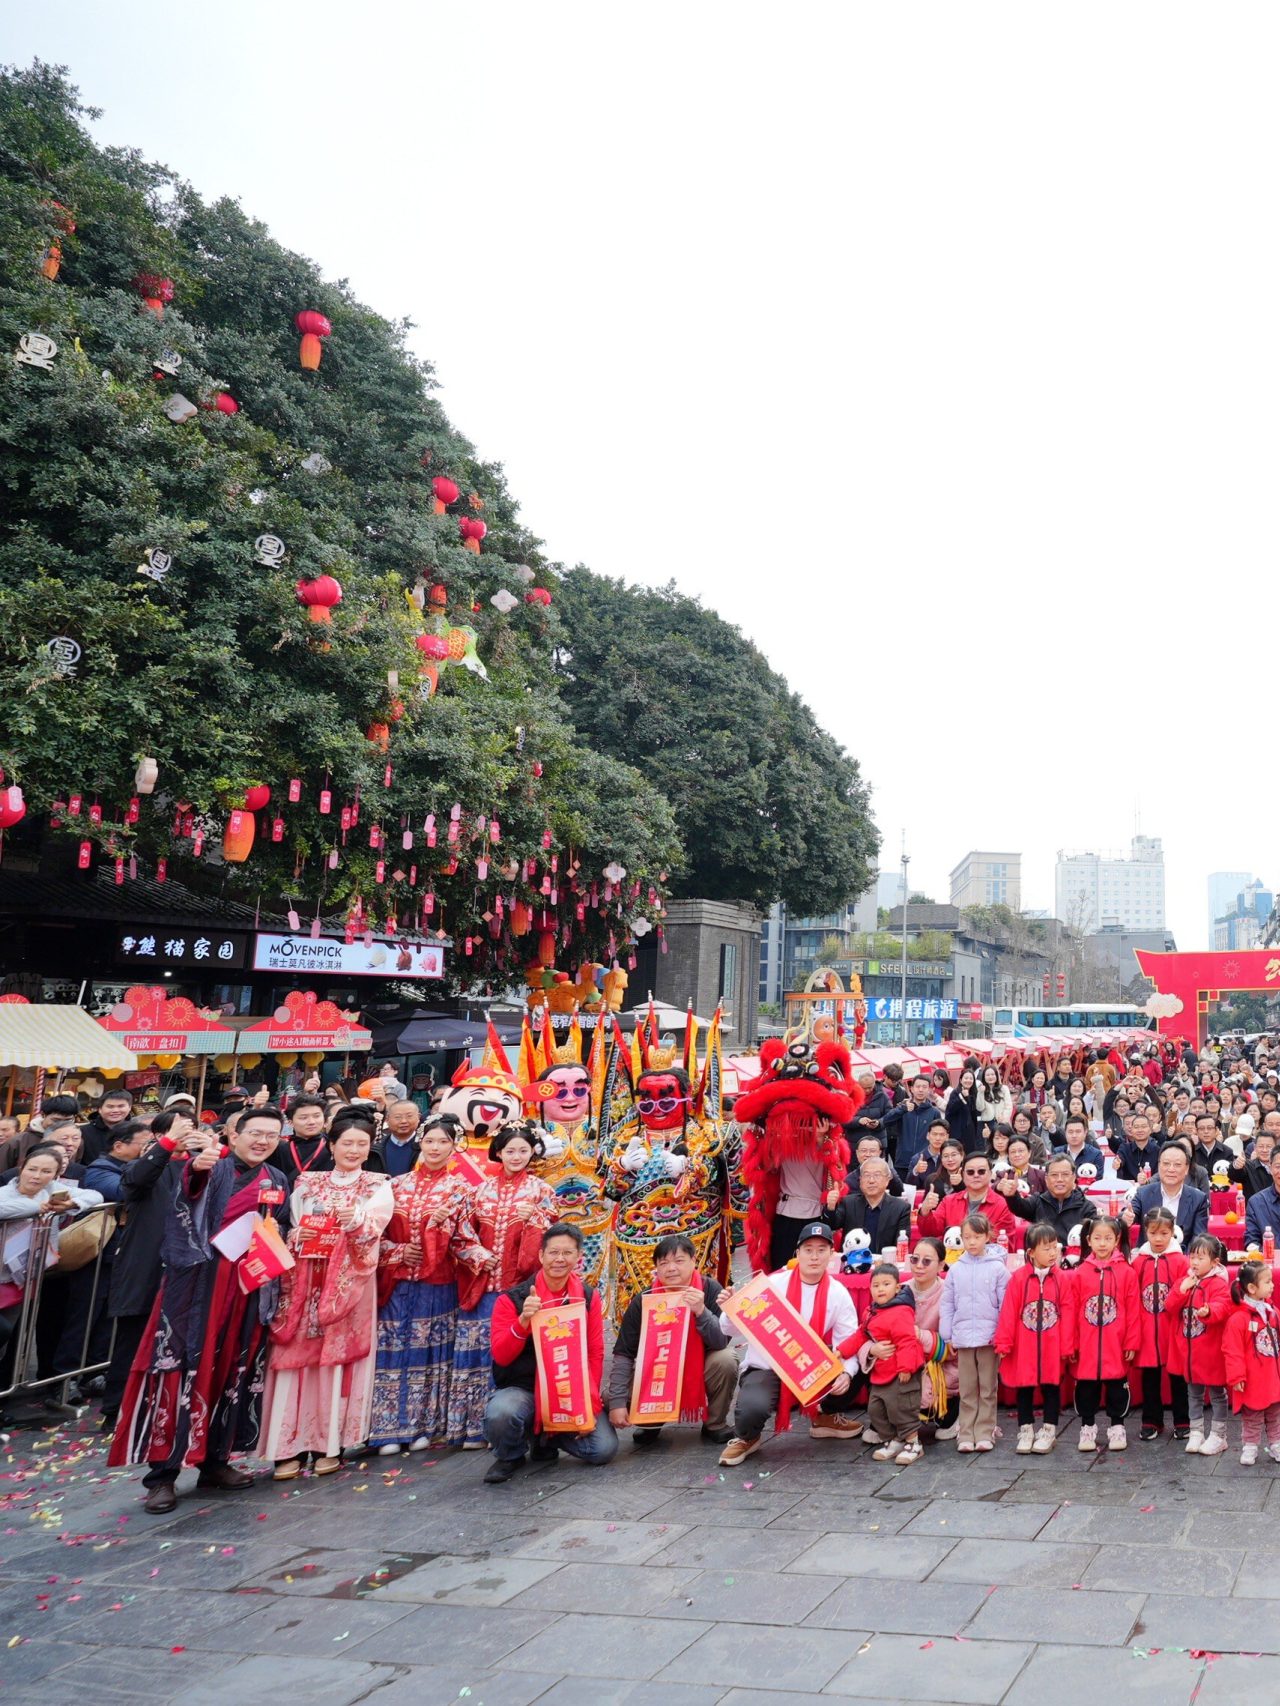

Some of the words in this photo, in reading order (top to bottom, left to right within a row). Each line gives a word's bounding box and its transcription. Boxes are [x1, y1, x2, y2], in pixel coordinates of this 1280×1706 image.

[136, 936, 234, 960] 熊猫家园
[269, 957, 342, 970] 瑞士莫凡彼冰淇淋
[889, 999, 955, 1019] 携程旅游
[799, 1360, 833, 1390] 2026
[640, 1402, 673, 1414] 2026
